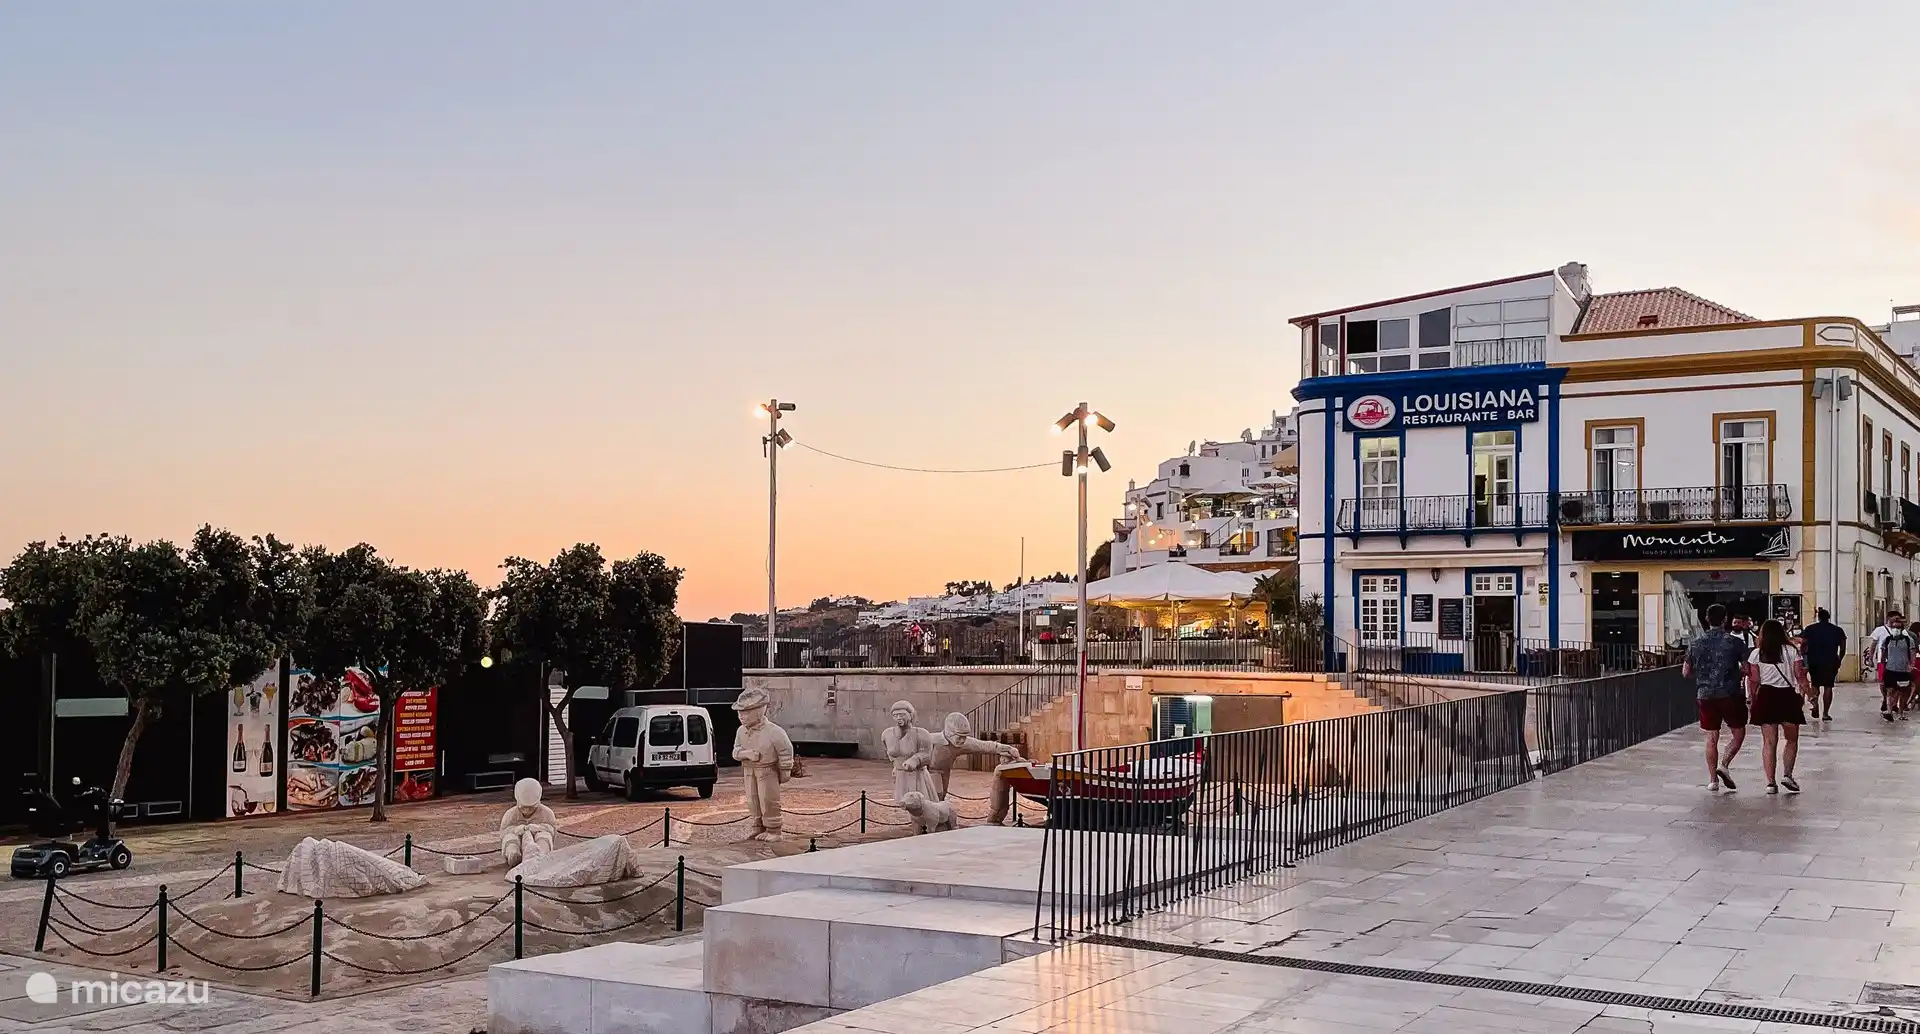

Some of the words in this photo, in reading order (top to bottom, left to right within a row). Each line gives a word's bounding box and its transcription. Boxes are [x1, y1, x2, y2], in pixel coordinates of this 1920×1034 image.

[1402, 388, 1534, 413] LOUISIANA
[1402, 411, 1498, 425] RESTAURANTE
[1507, 408, 1535, 420] BAR
[1622, 531, 1735, 549] Moments
